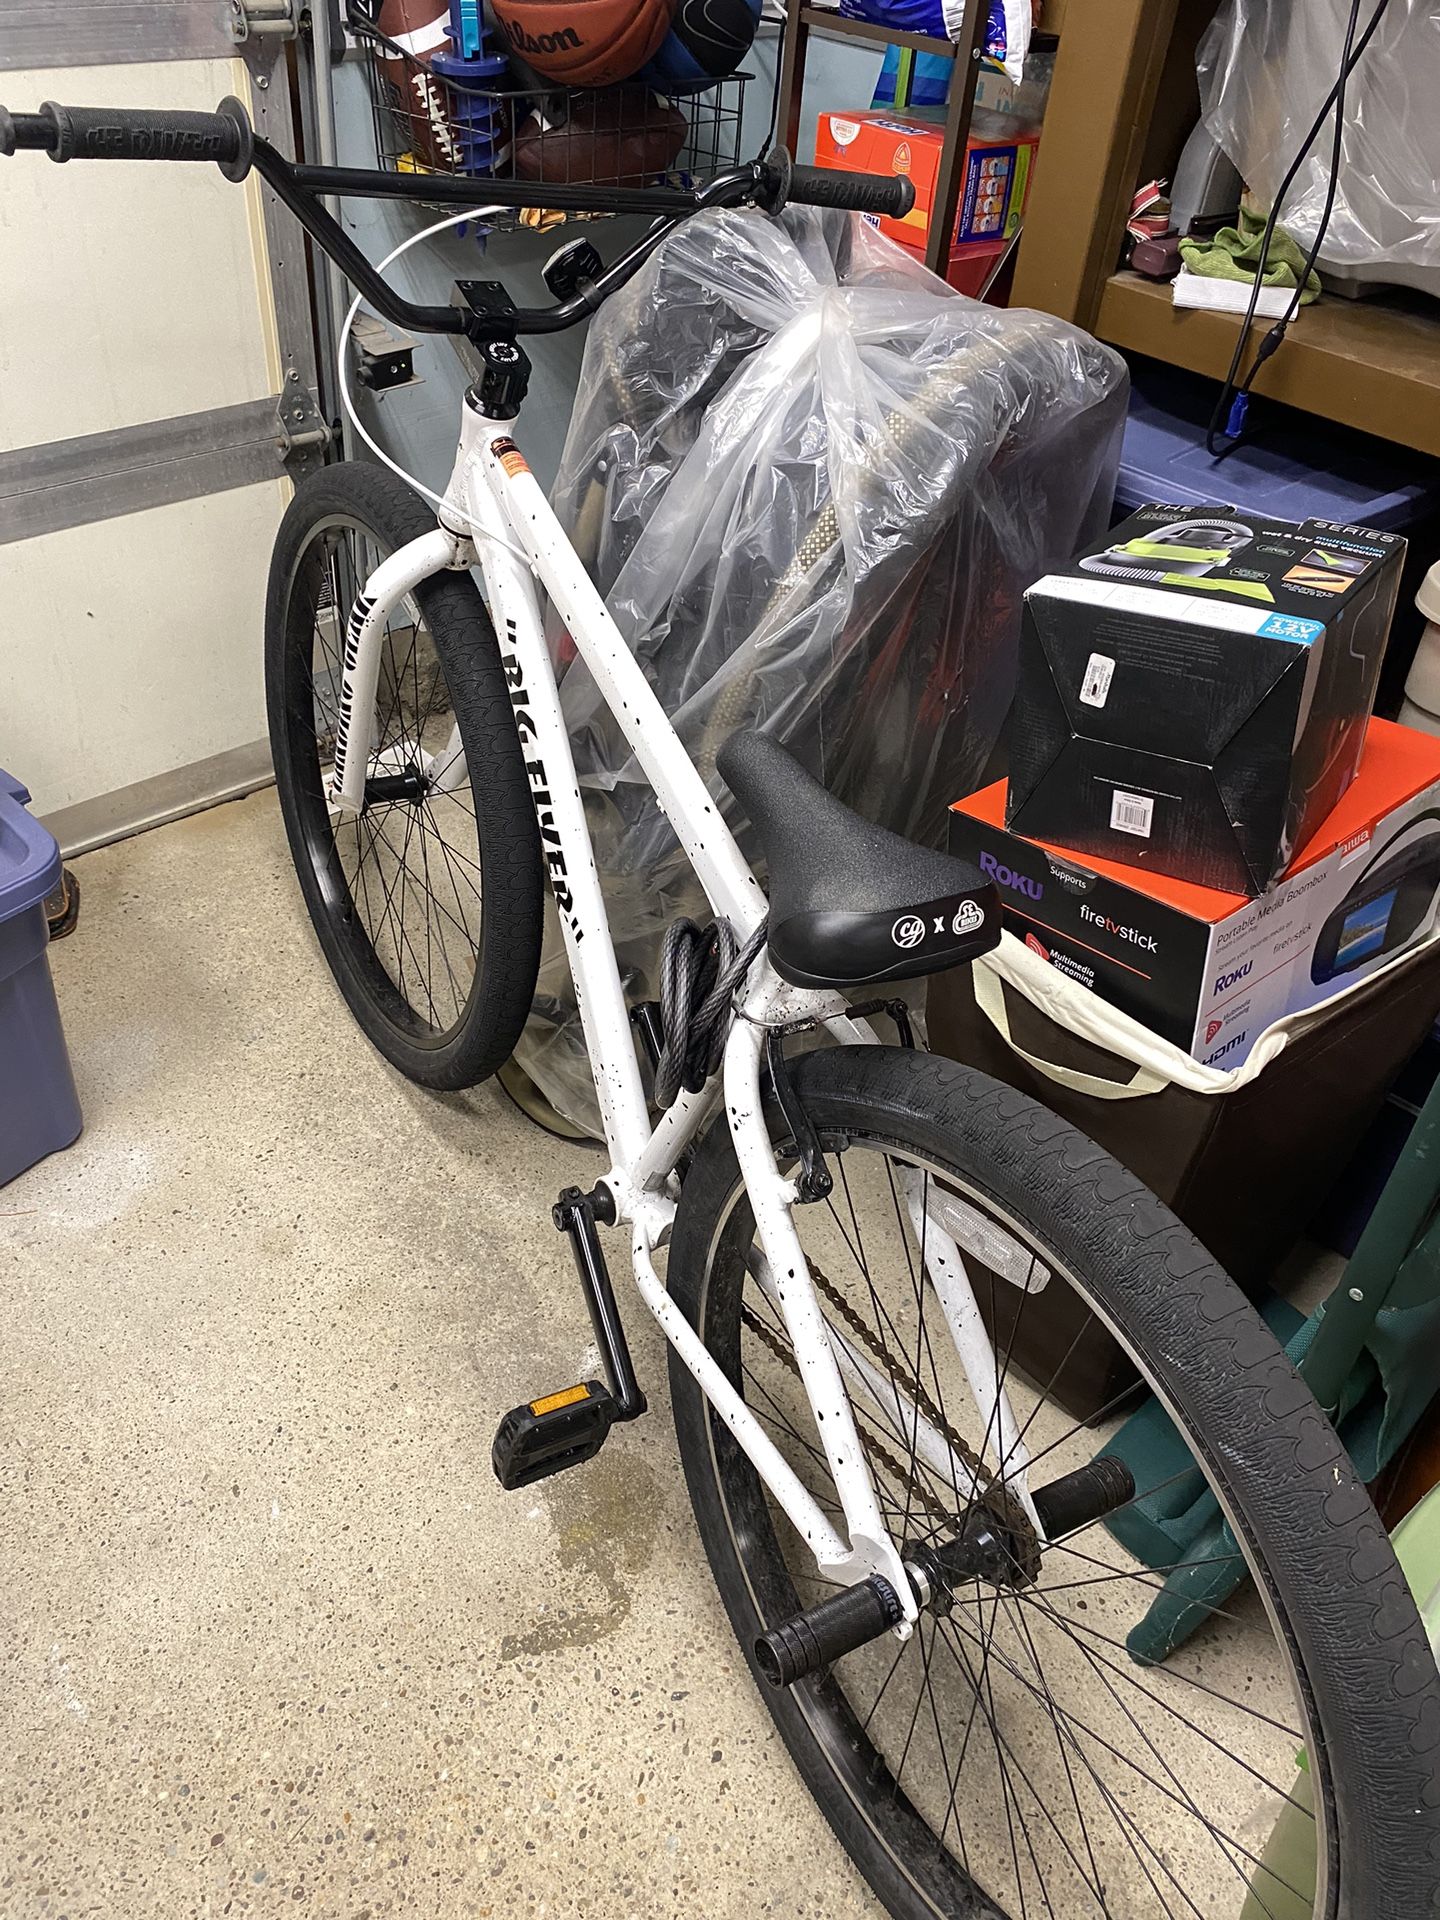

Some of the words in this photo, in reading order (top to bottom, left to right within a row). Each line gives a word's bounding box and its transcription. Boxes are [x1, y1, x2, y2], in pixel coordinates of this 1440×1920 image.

[1154, 504, 1194, 513] THE
[1294, 535, 1313, 543] dry
[1313, 521, 1396, 544] SERIES
[1315, 536, 1386, 555] multifunction
[1340, 546, 1383, 558] vacuum
[1264, 627, 1310, 639] MOTOR
[1270, 621, 1315, 634] 12V
[1272, 616, 1321, 632] POWERFUL
[979, 850, 1044, 901] ROKU
[1050, 866, 1087, 889] Supports
[1216, 915, 1256, 947] Portable
[1257, 898, 1285, 922] Media
[1286, 871, 1329, 903] Boombox
[1079, 904, 1159, 954] firetvstick
[1050, 949, 1095, 978] Multimedia
[1053, 960, 1095, 988] Streaming
[1213, 960, 1254, 997] ROKU
